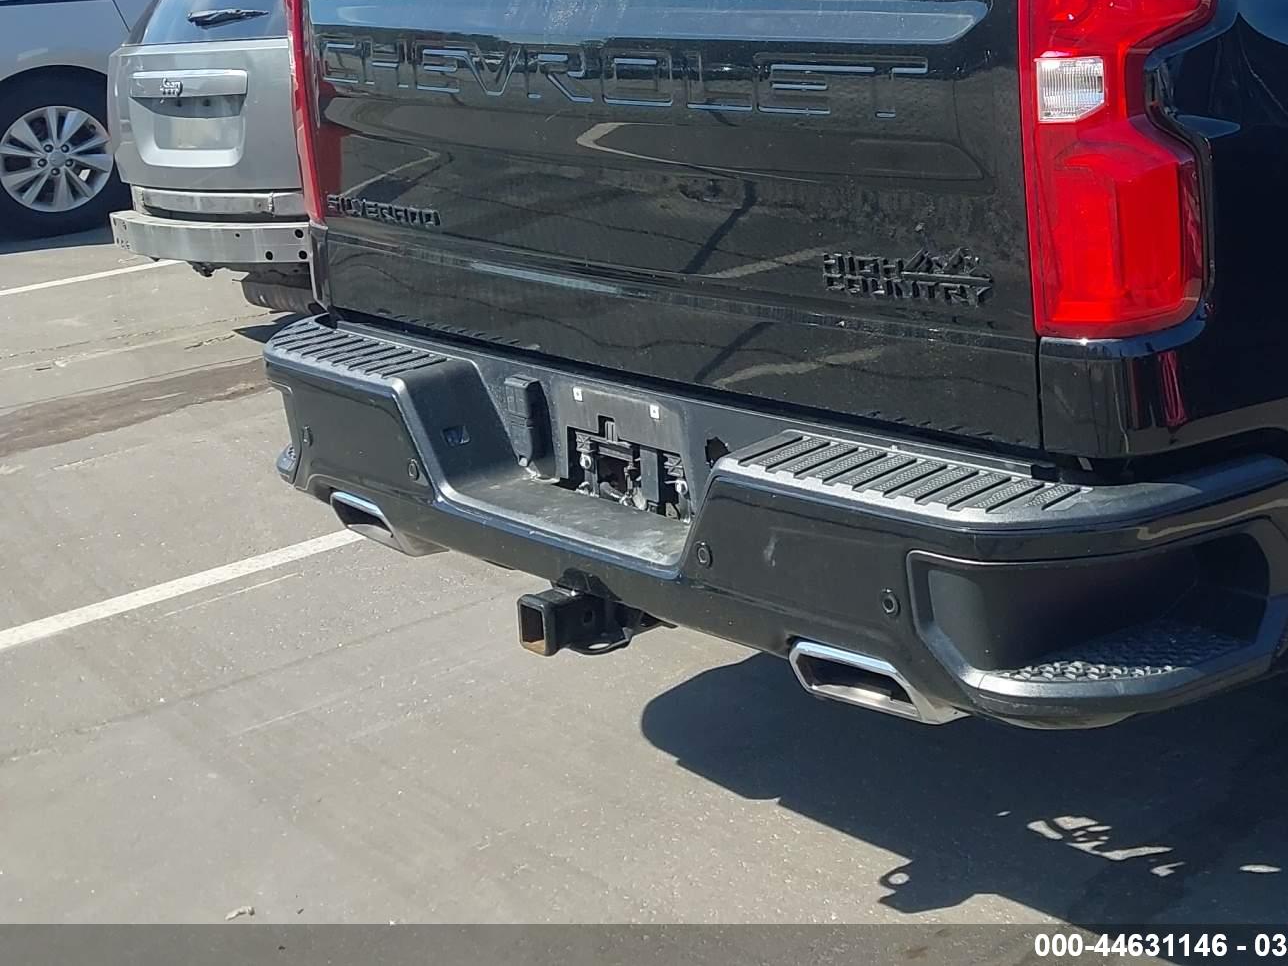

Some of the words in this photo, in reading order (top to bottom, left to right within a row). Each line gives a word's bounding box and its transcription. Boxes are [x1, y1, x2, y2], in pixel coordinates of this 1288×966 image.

[317, 34, 929, 119] CHEVROLET
[325, 194, 441, 228] SILVERADO
[823, 251, 905, 282] HIGH
[823, 273, 993, 308] COUNTRY
